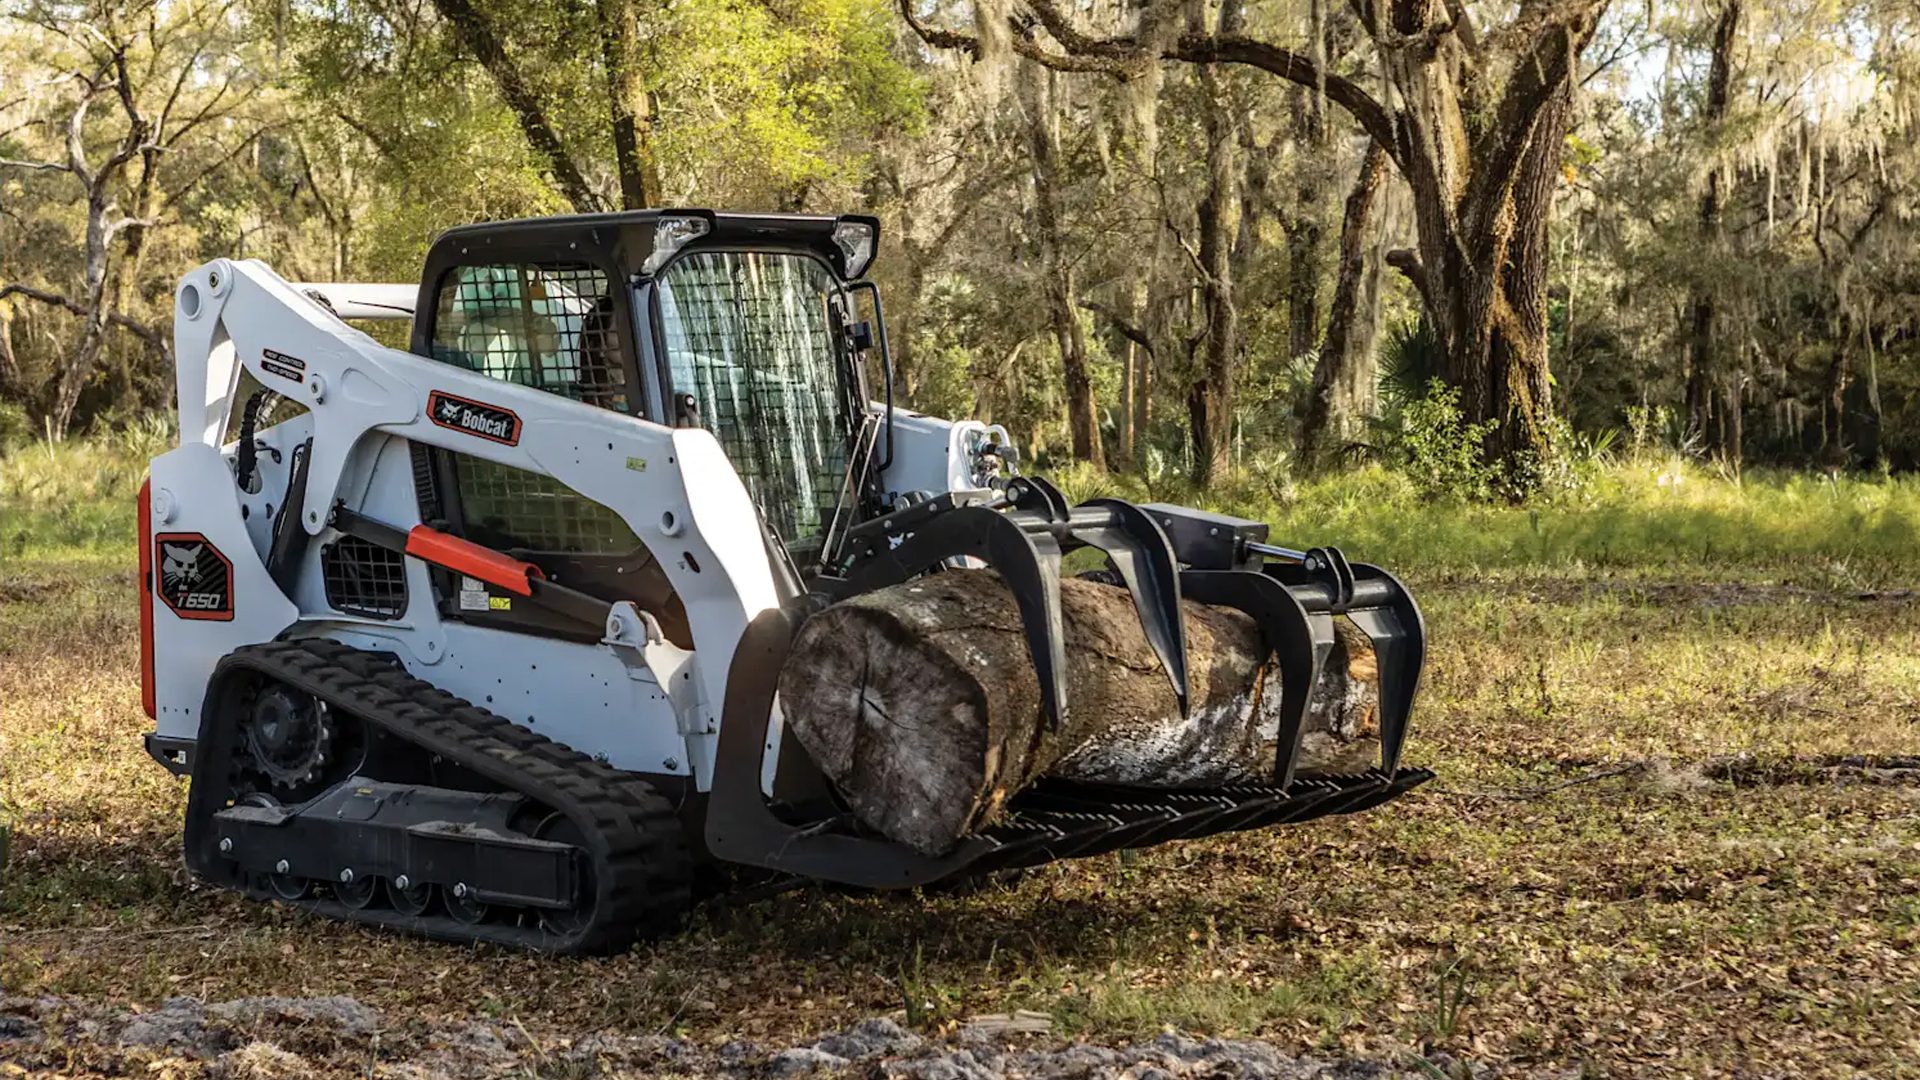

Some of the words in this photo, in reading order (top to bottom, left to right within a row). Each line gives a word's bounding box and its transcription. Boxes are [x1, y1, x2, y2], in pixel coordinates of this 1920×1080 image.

[279, 355, 304, 369] CONTROL
[461, 409, 507, 437] Bobcat
[177, 592, 220, 609] T650
